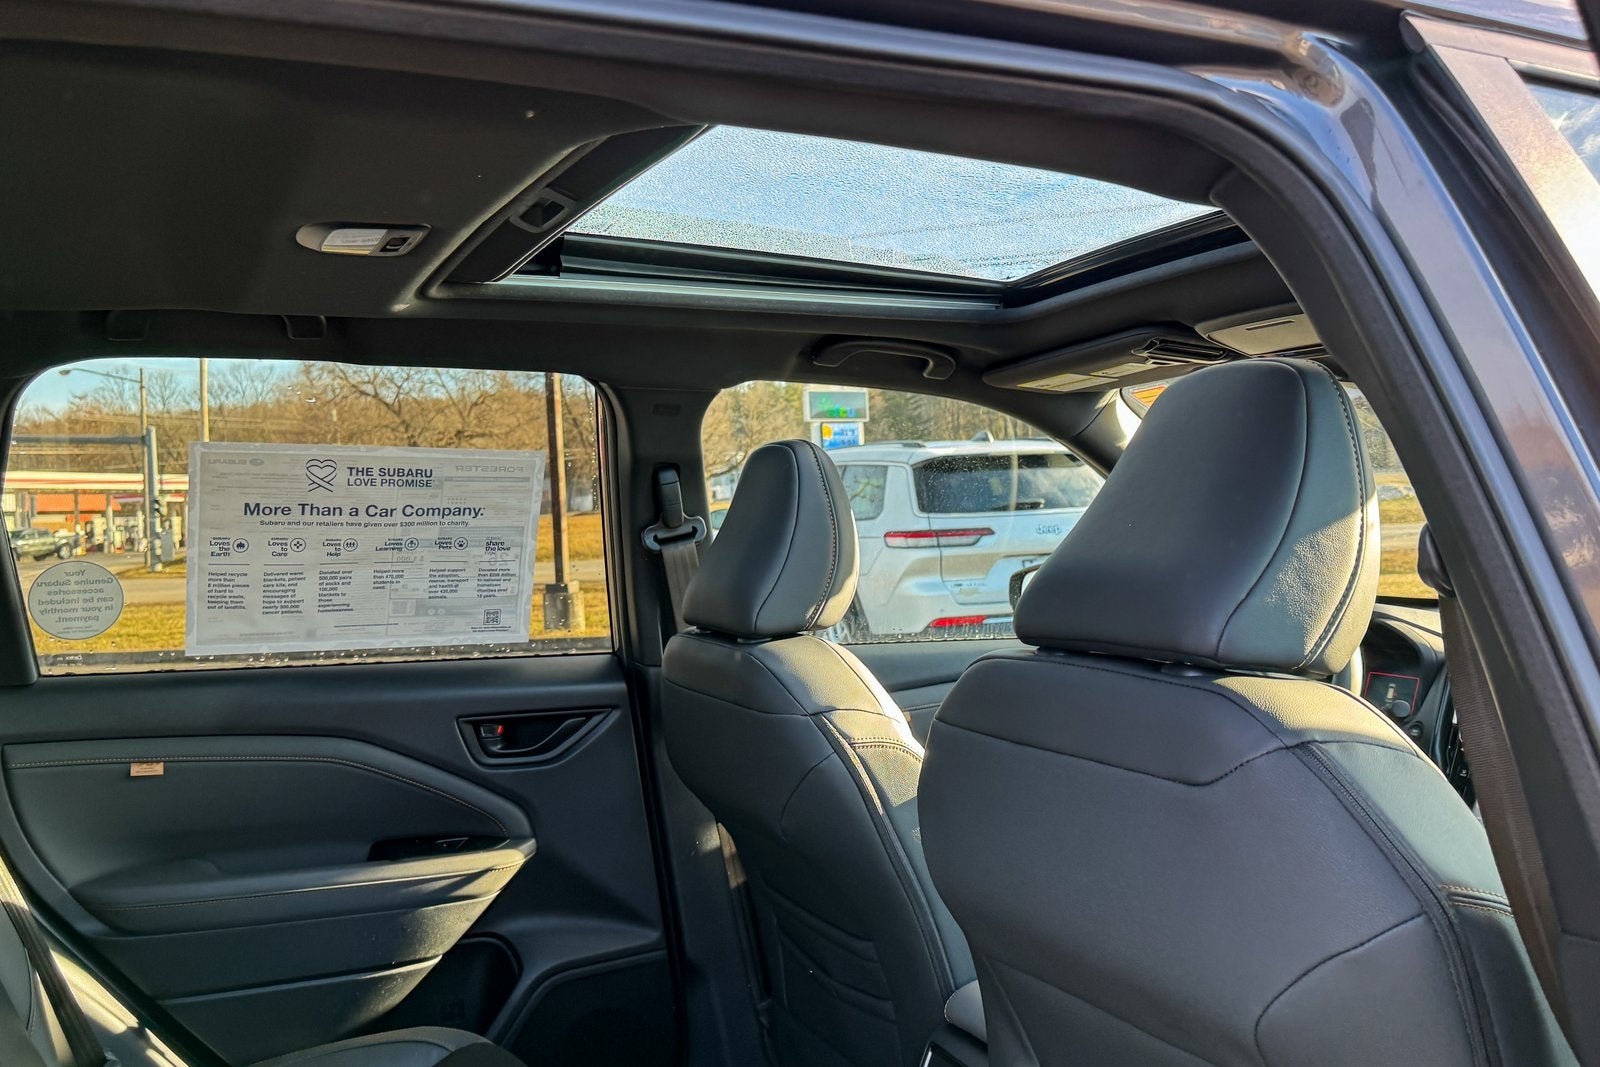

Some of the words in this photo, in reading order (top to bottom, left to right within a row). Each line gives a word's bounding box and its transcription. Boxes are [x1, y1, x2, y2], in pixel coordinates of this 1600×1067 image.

[347, 466, 374, 476] THE
[378, 468, 433, 478] SUBARU
[348, 478, 377, 487] LOVE
[244, 503, 292, 516] More
[298, 504, 342, 516] Than
[349, 506, 359, 516] a
[366, 504, 396, 517] Car
[1036, 524, 1062, 535] Jeep
